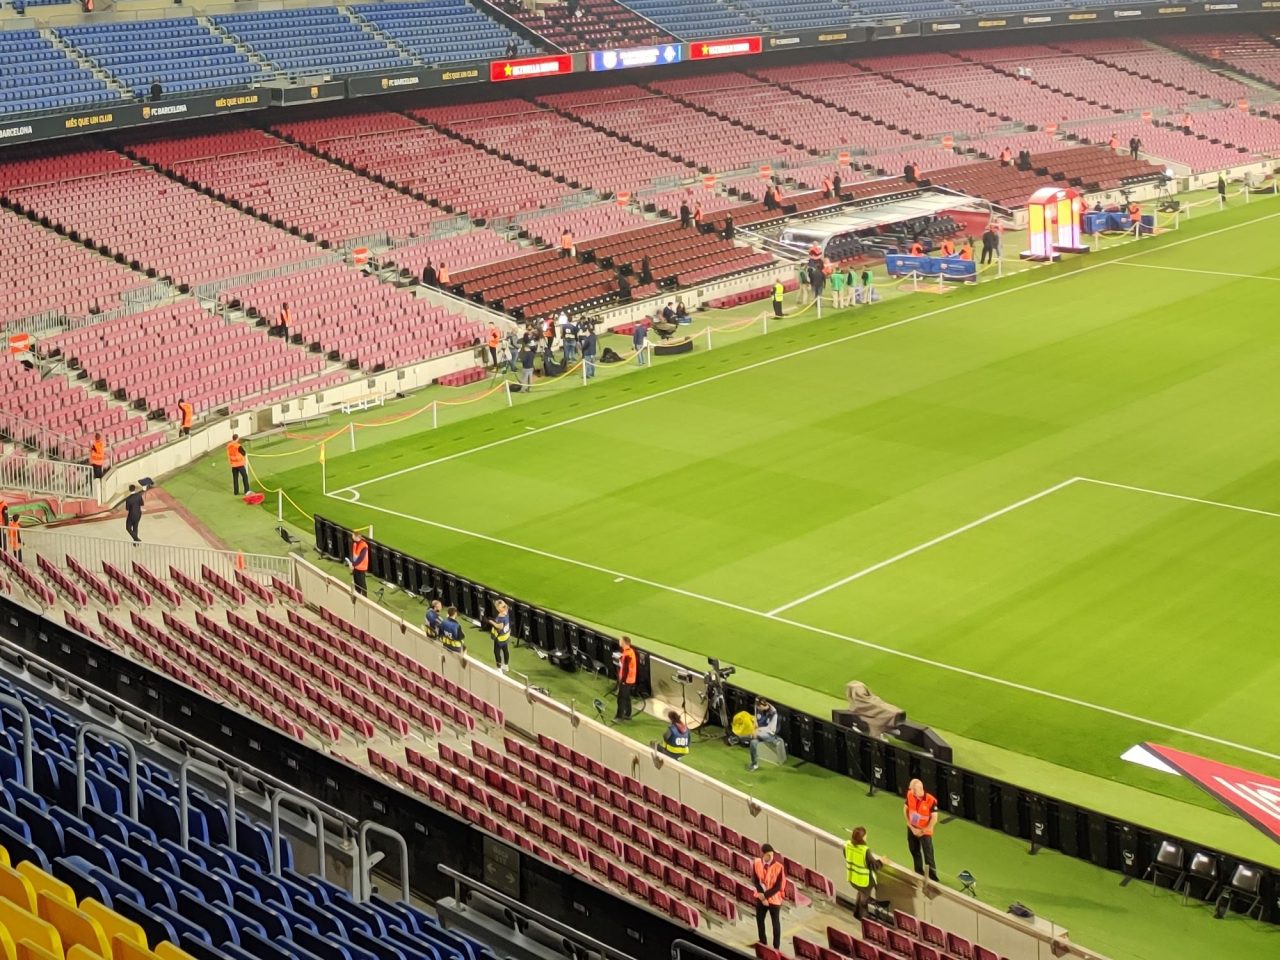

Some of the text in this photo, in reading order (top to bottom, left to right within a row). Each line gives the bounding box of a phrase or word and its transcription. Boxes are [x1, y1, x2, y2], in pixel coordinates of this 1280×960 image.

[394, 77, 419, 86] BARCELONA
[216, 98, 226, 108] MÉS
[227, 97, 237, 107] QUE
[237, 96, 245, 104] UN
[151, 105, 187, 116] FC BARCELONA
[66, 114, 112, 128] MÉS QUE UN CLUB
